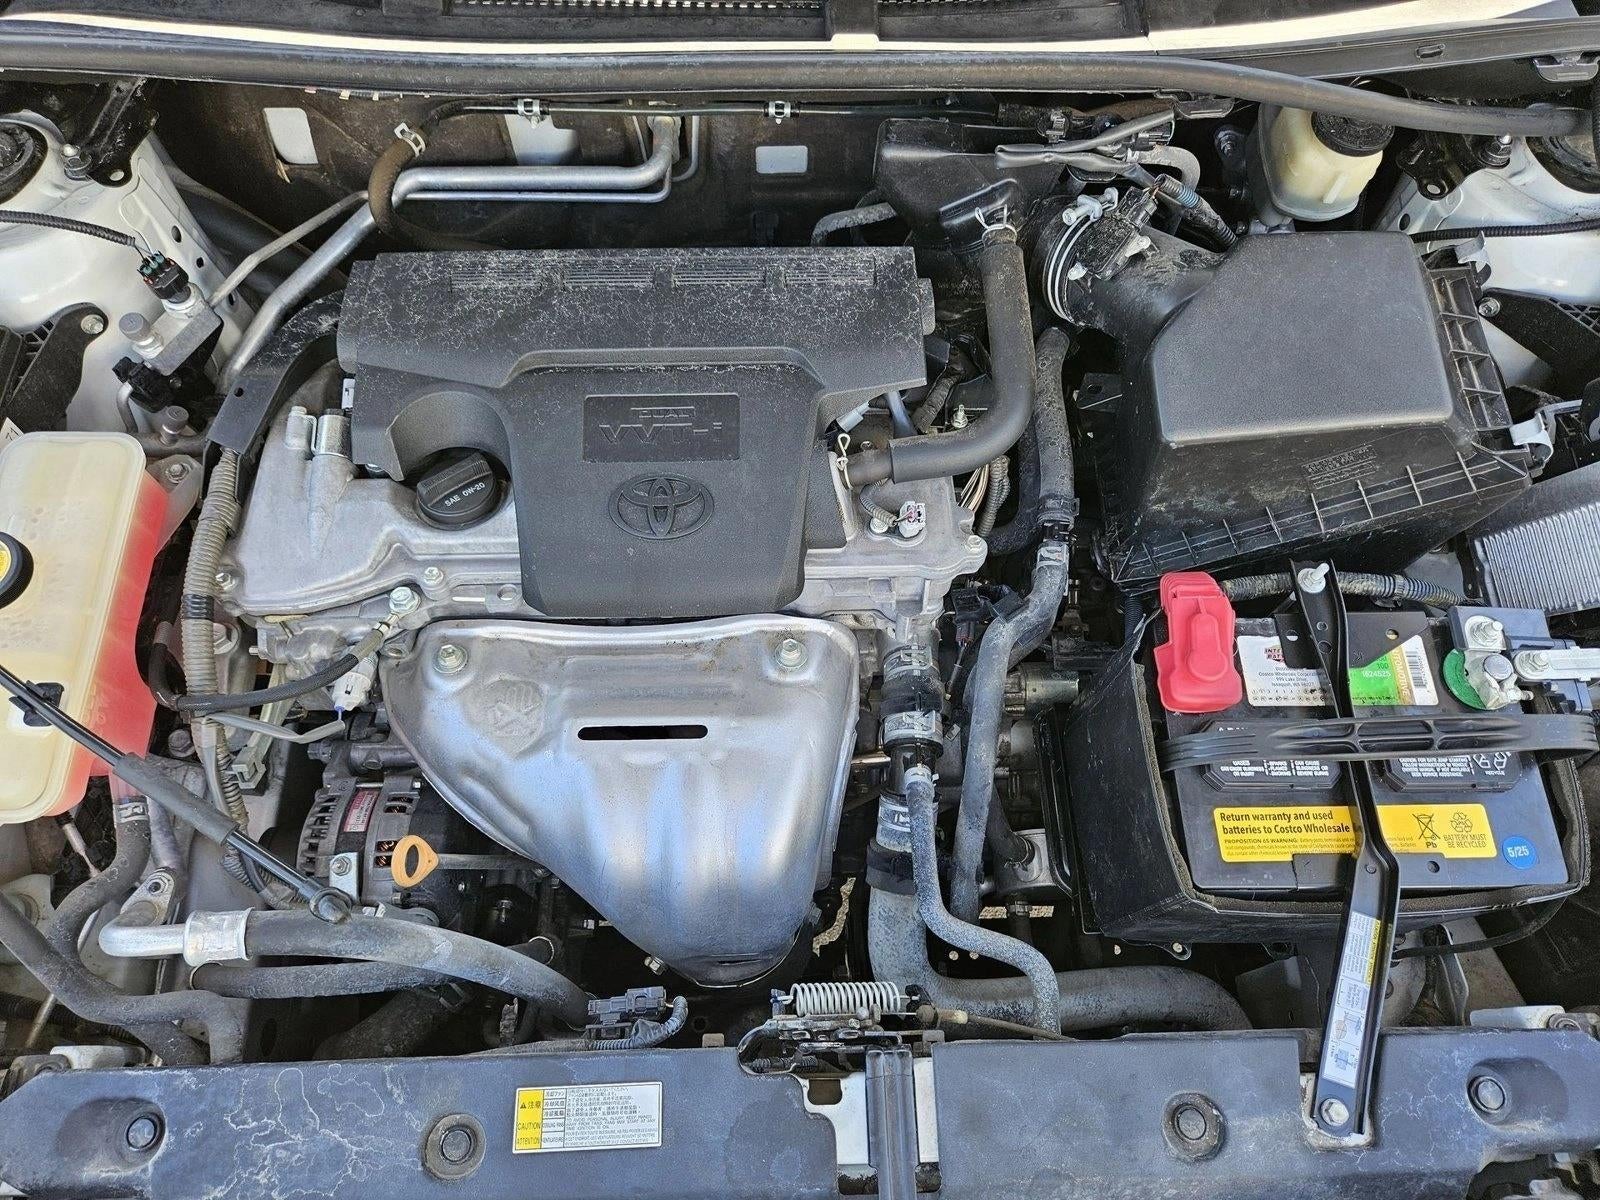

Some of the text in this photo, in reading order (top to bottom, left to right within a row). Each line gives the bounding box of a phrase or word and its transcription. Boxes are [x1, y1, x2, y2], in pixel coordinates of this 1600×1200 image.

[444, 482, 486, 507] SAE 0W-20
[1220, 810, 1333, 823] Return warranty and used
[1222, 823, 1350, 834] batteries to Costco Wholesale
[1469, 833, 1487, 841] MUST
[1425, 841, 1438, 849] Pb
[1456, 840, 1487, 848] RECYCLED
[1507, 845, 1529, 858] 5/25
[517, 1122, 541, 1130] CAUTION
[516, 1137, 540, 1145] ATTENTION
